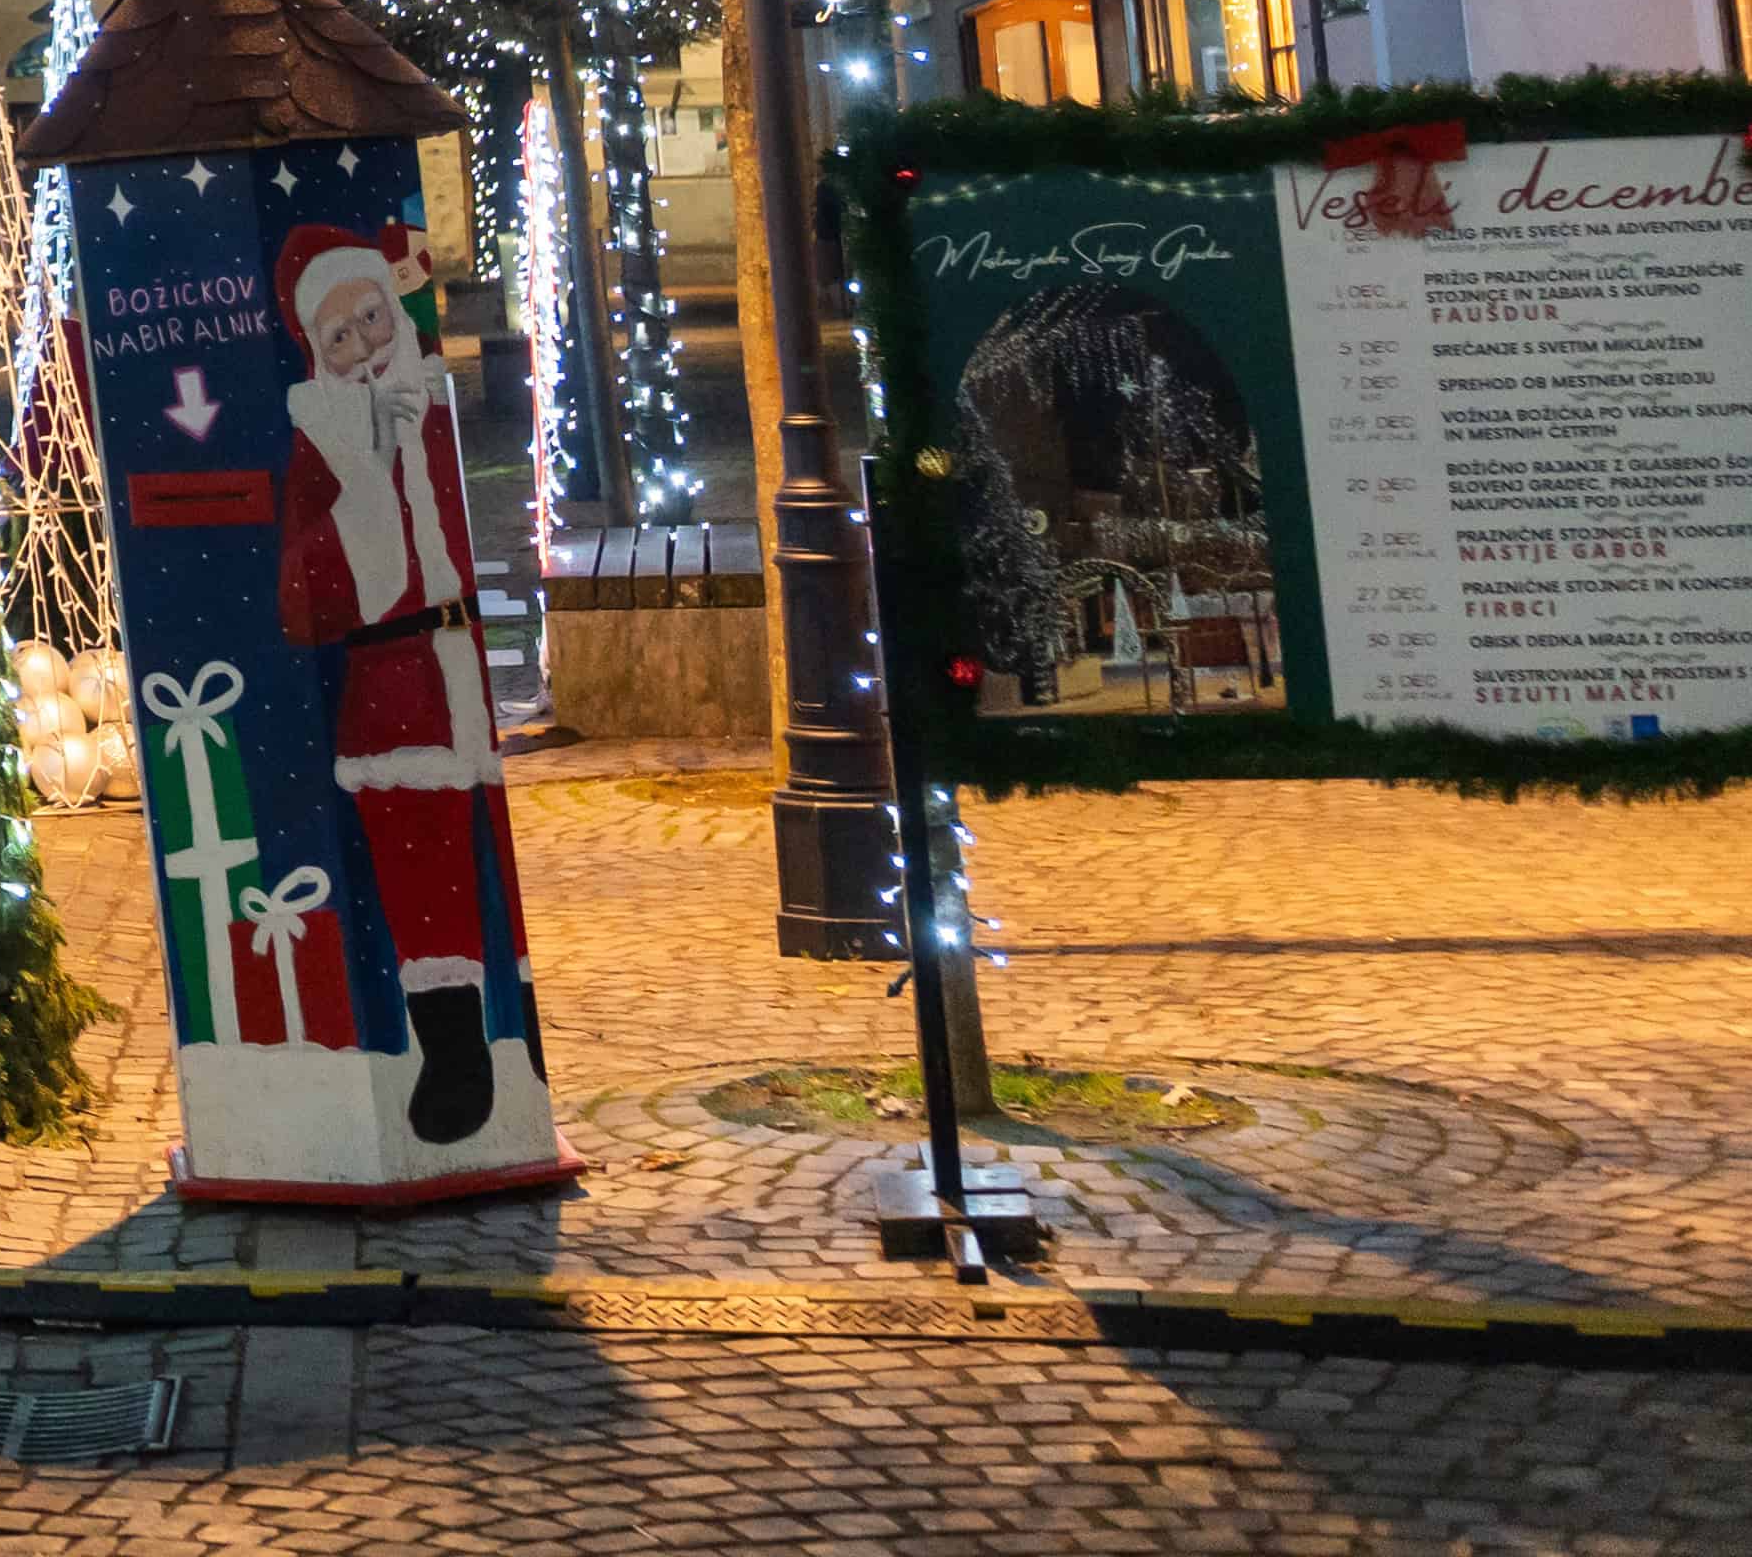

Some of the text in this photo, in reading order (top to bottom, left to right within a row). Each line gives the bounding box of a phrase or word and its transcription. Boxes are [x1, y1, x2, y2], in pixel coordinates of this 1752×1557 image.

[1586, 222, 1611, 235] NA
[1514, 288, 1533, 301] IN
[1522, 376, 1546, 389] OB
[1599, 406, 1623, 419] PO
[1444, 428, 1464, 441] IN
[1585, 494, 1619, 508] POD
[1571, 541, 1666, 559] GABOR
